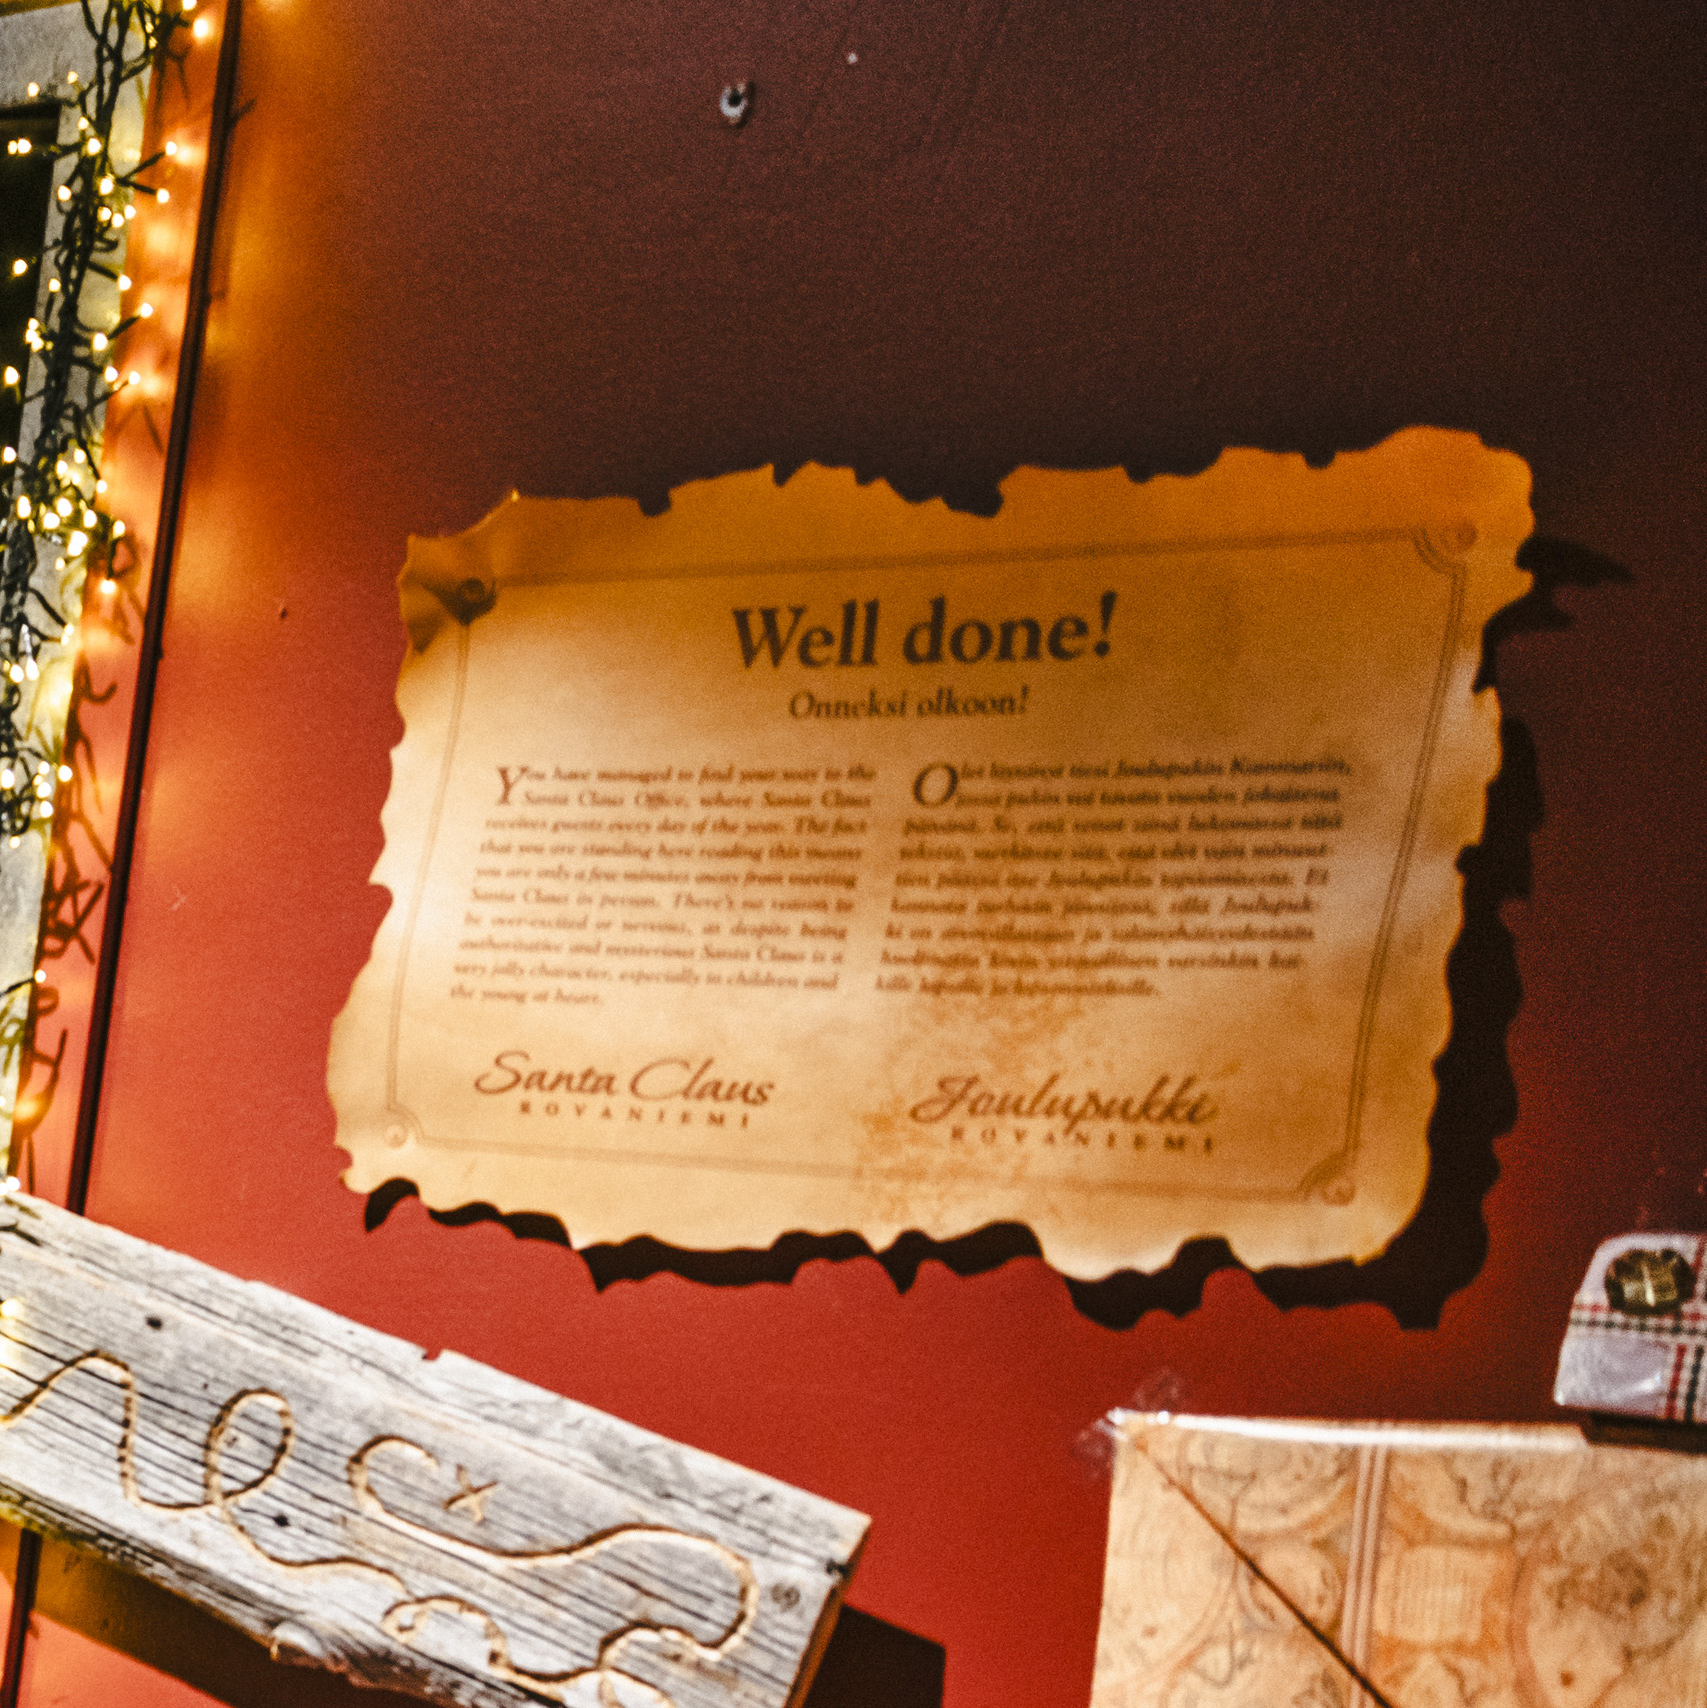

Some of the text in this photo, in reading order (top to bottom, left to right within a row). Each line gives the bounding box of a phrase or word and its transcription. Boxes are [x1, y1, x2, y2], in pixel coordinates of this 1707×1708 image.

[731, 590, 1118, 669] Well done!
[789, 683, 1029, 720] Onneksi olkoon!
[474, 1050, 775, 1107] Santa Claus
[909, 1072, 1220, 1137] Joulupukki
[520, 1100, 749, 1129] ROVANIEMI
